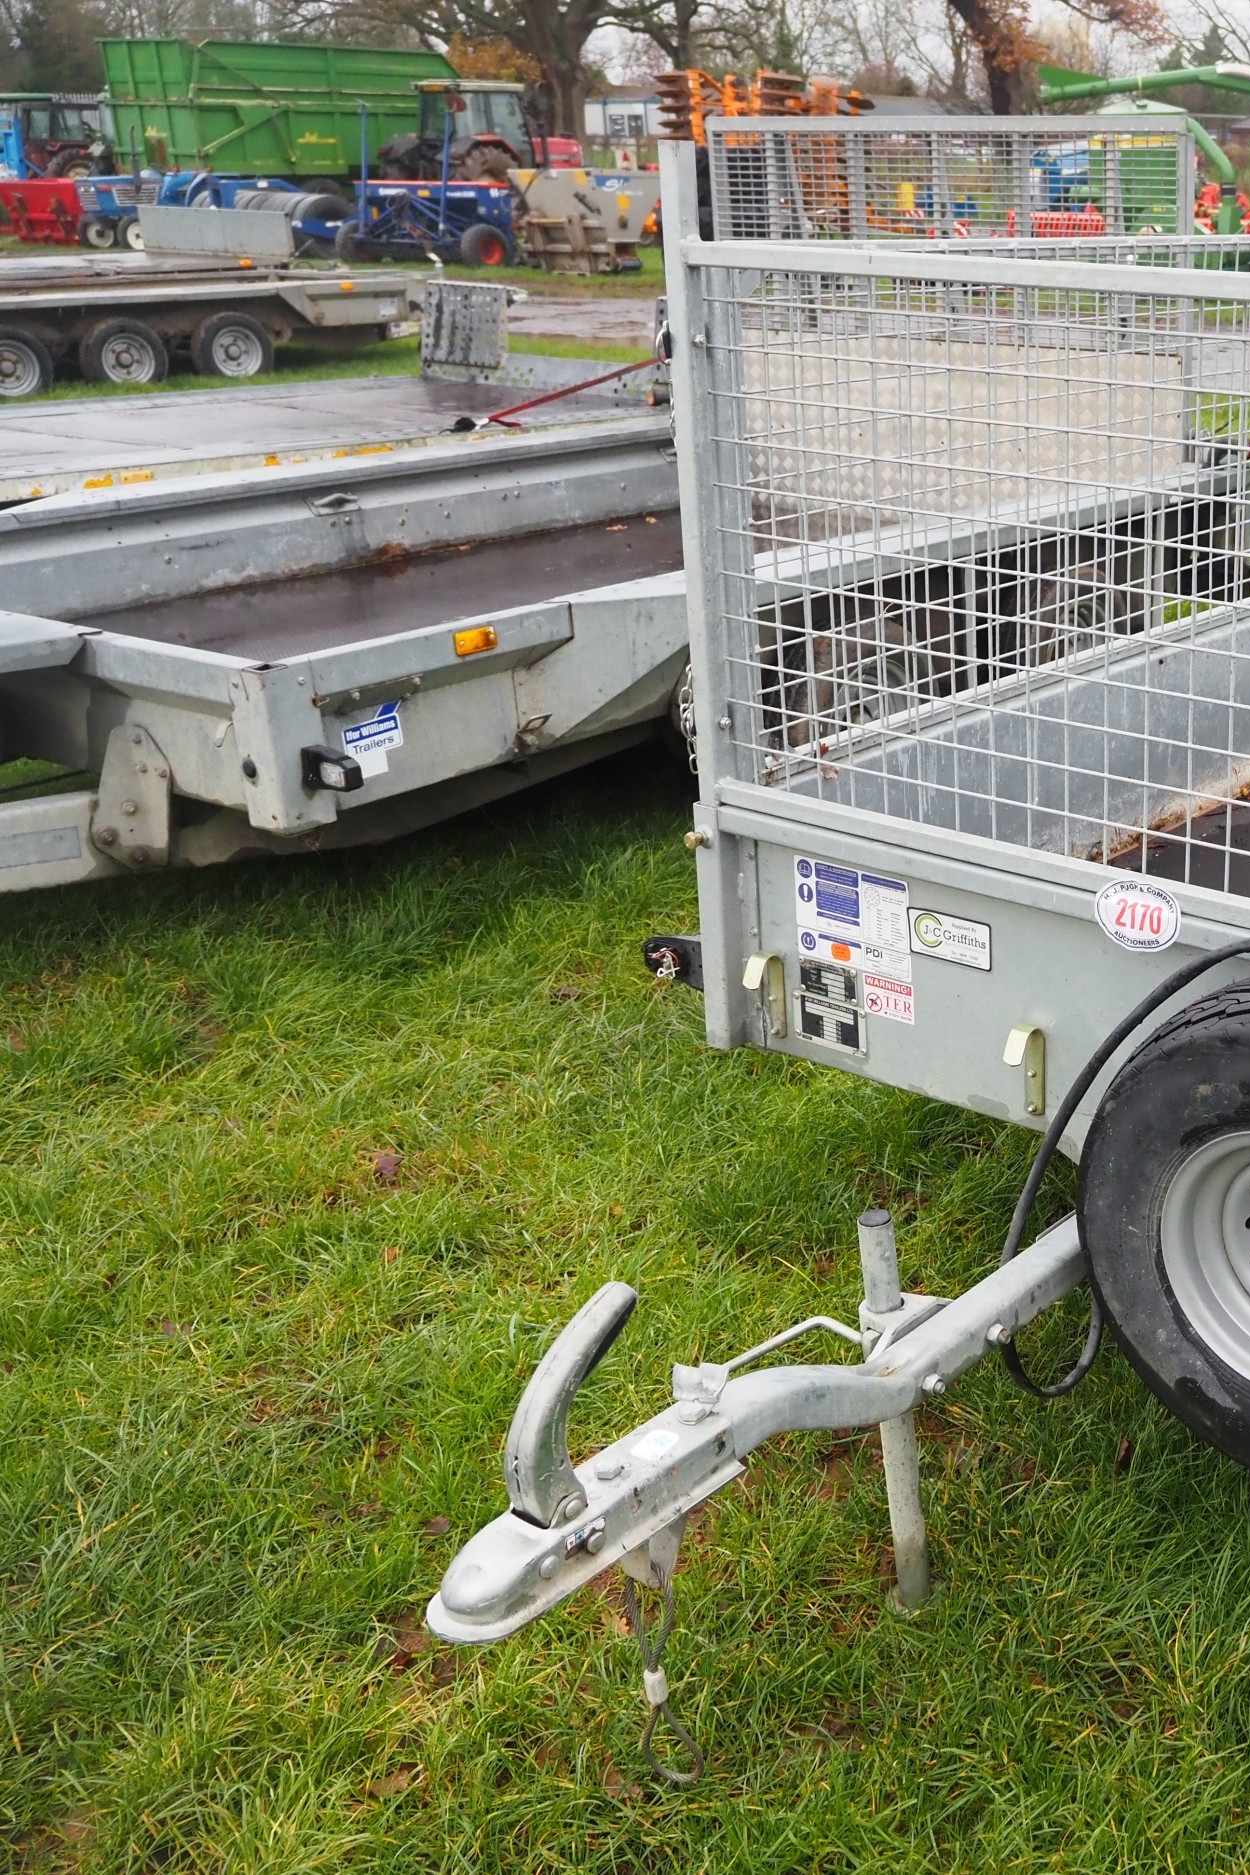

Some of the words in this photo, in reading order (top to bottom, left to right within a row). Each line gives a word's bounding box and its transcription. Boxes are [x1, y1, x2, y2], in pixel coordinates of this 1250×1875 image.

[360, 719, 396, 737] Williams
[353, 735, 395, 755] Trailers
[1120, 883, 1139, 891] PUGH
[1146, 886, 1175, 914] COMPANY
[1115, 897, 1163, 935] 2170
[943, 929, 987, 950] Griffiths
[1113, 930, 1160, 947] AUCTIONEERS
[865, 947, 883, 960] PDI
[865, 976, 911, 994] WARNING!
[883, 995, 912, 1015] TER
